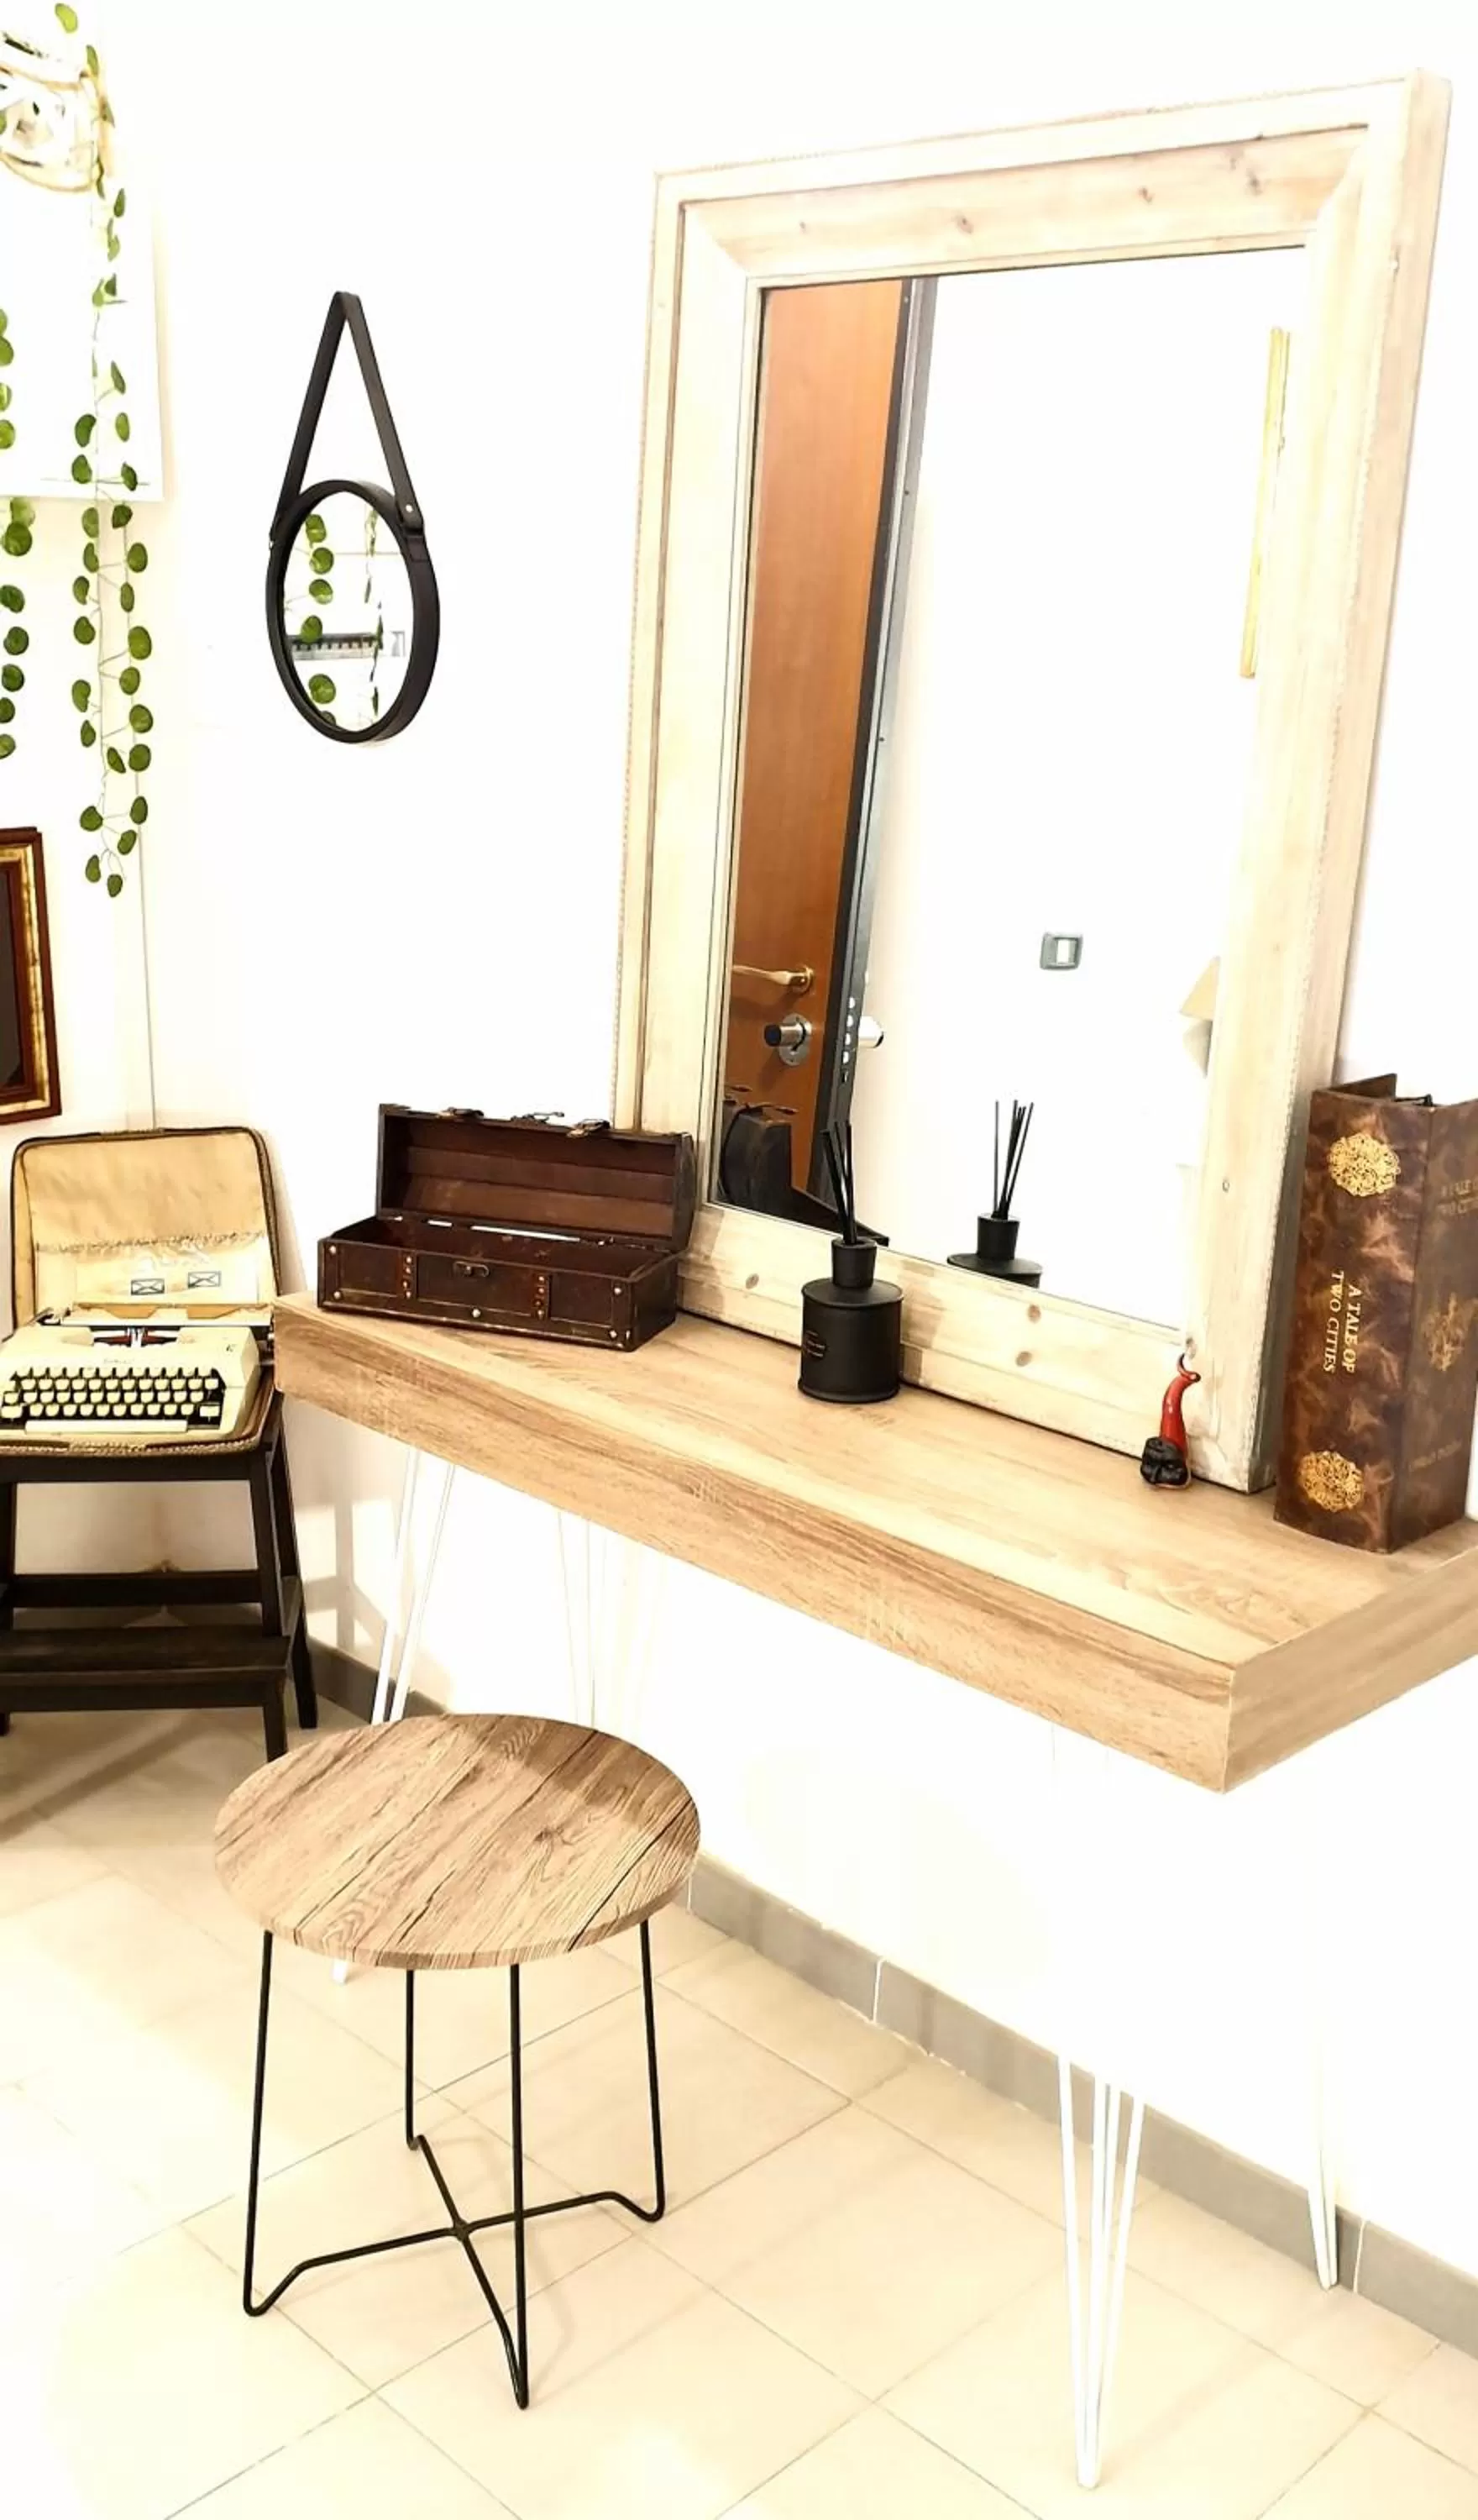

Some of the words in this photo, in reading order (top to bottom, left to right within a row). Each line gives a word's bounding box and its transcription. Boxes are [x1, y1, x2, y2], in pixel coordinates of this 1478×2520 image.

[1329, 1270, 1344, 1312] TWO
[1348, 1284, 1361, 1298] A
[1323, 1316, 1339, 1373] CITIES
[1344, 1303, 1360, 1346] TALE
